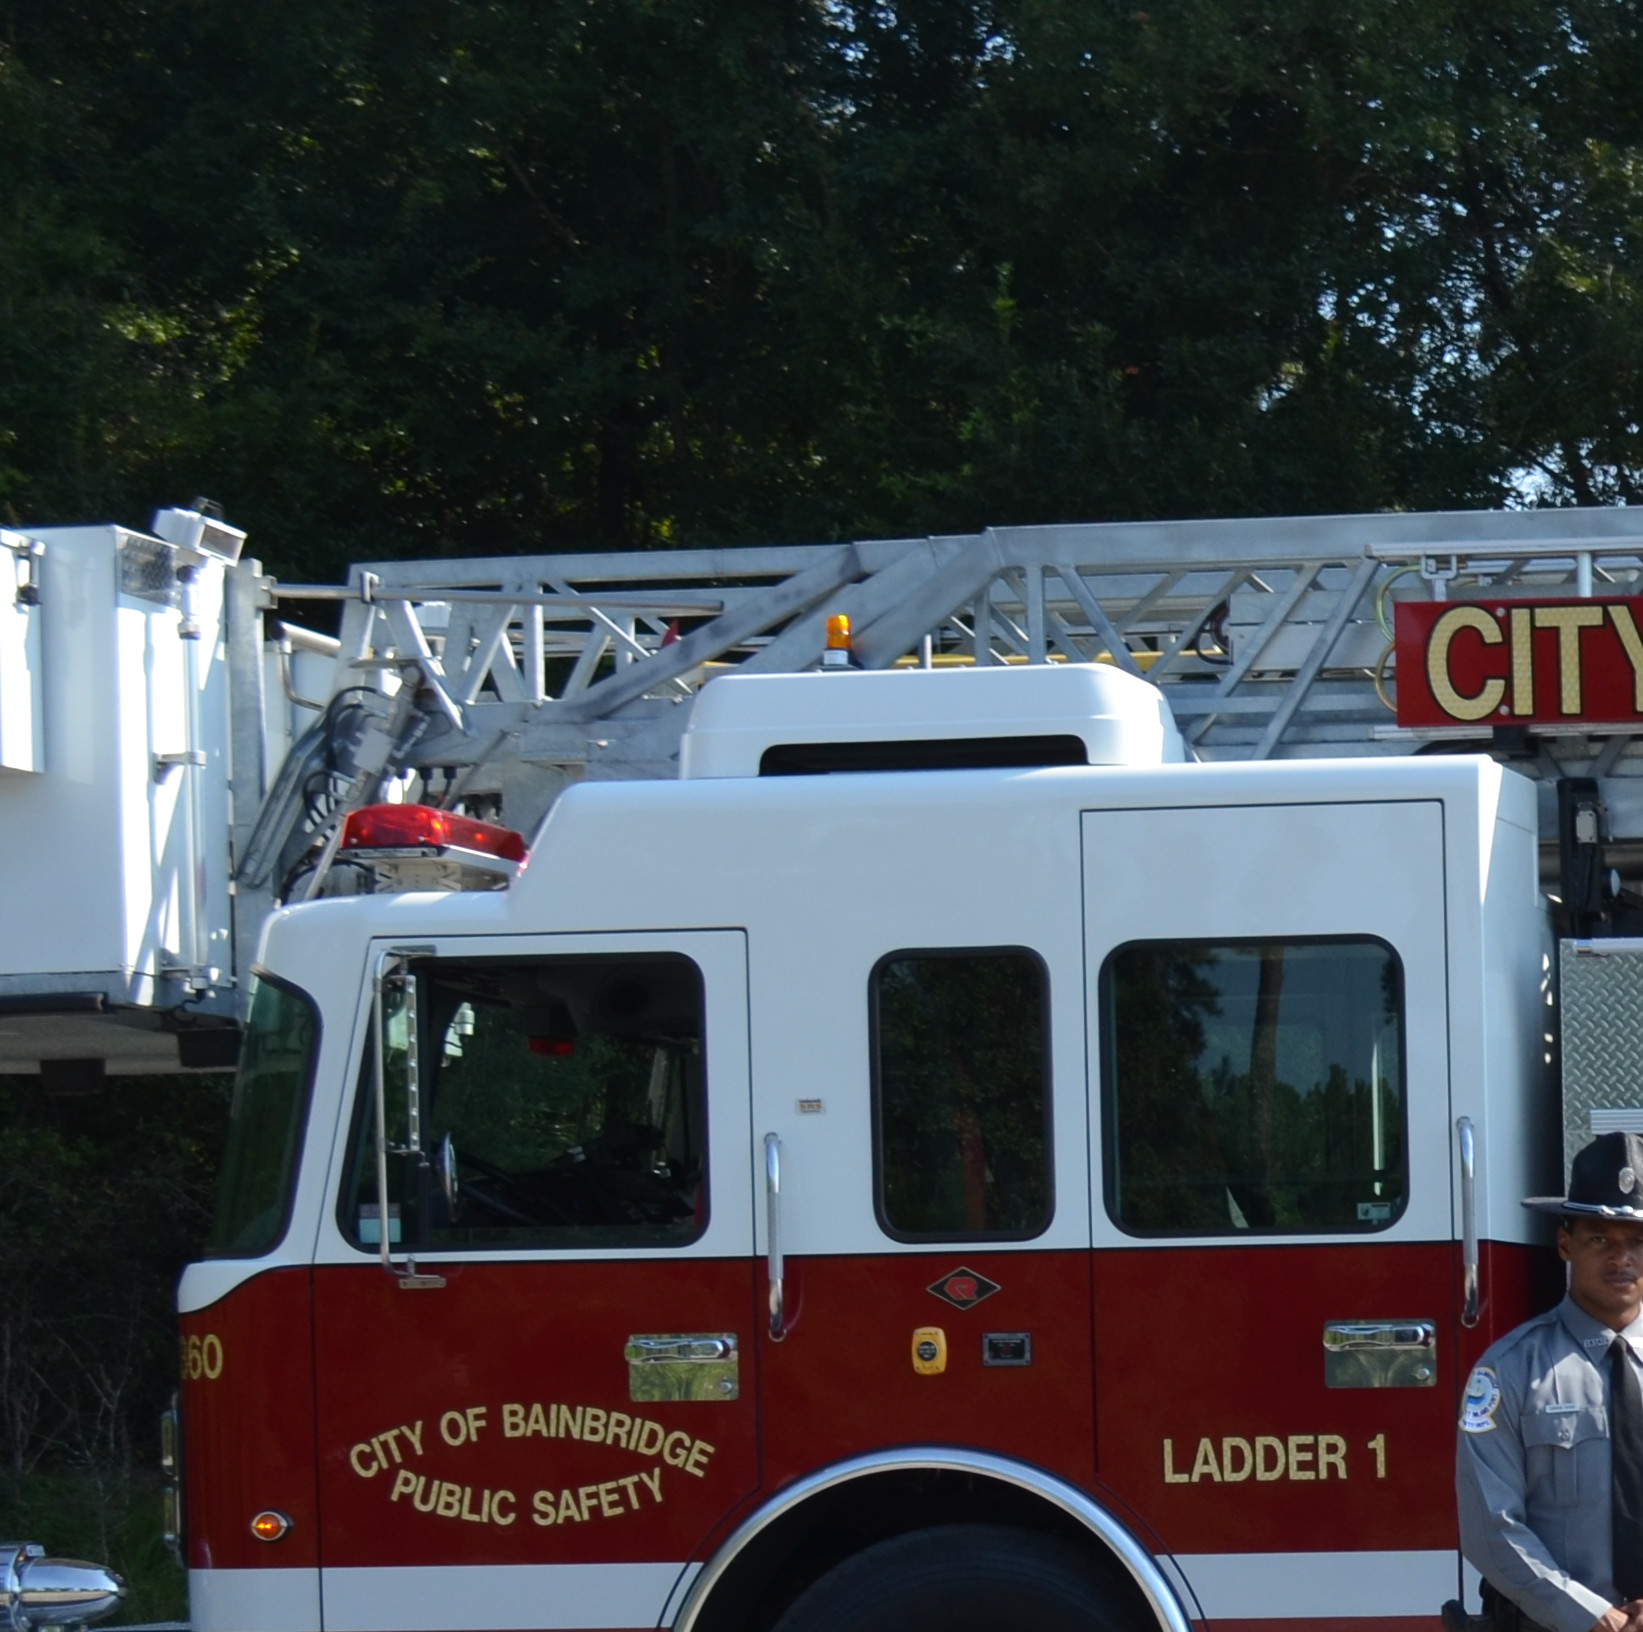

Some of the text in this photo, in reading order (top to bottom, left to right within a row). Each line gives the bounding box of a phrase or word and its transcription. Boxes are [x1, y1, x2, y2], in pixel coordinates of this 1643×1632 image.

[350, 1403, 715, 1478] CITY OF BAINBRIDGE
[1162, 1433, 1388, 1484] LADDER 1
[391, 1468, 665, 1527] PUBLIC SAFETY
